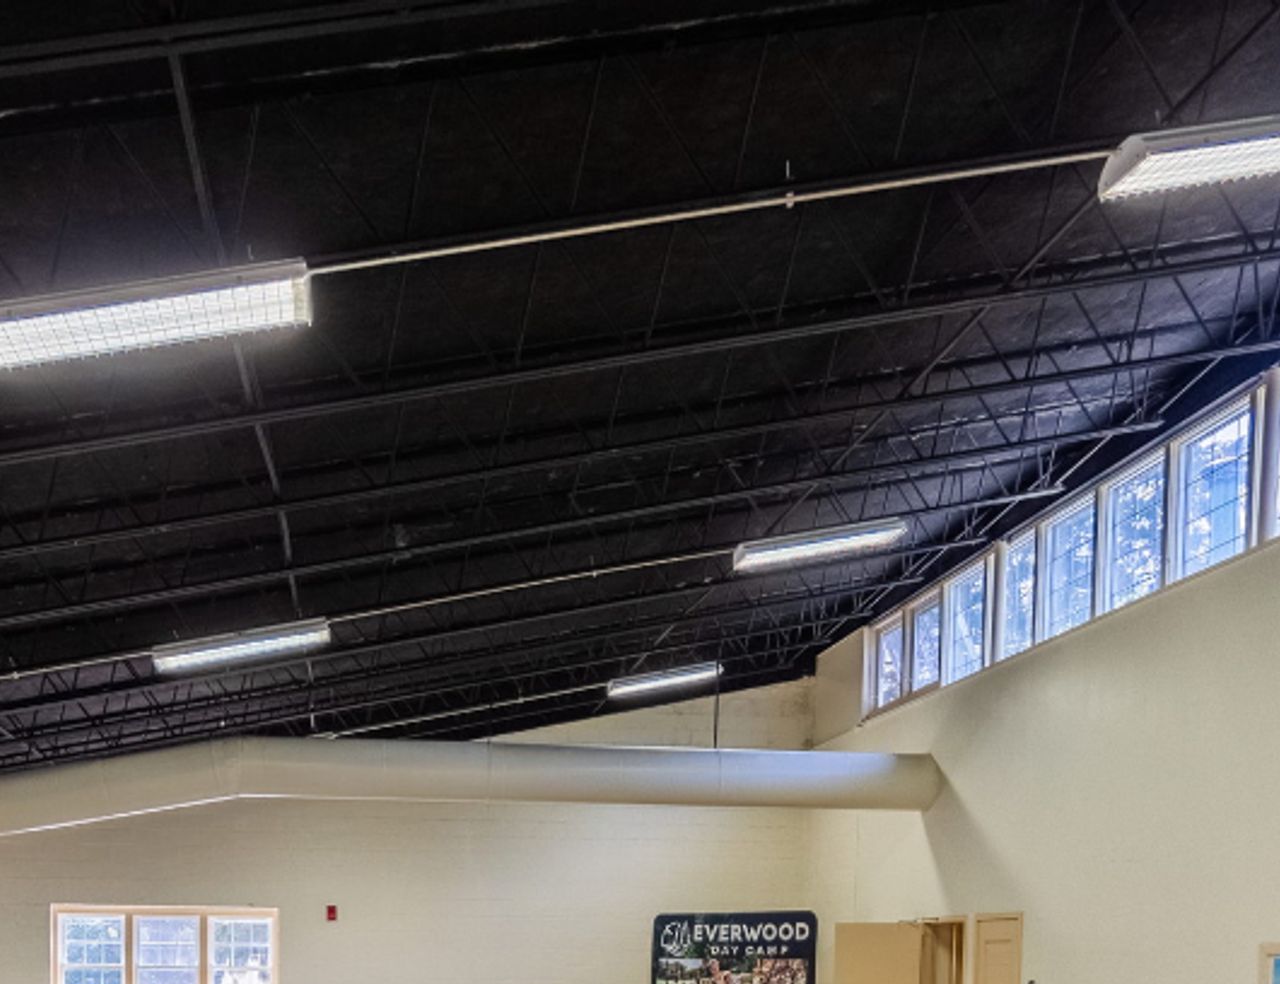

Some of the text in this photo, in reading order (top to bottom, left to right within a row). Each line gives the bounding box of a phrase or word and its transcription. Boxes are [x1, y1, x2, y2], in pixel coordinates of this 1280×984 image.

[693, 922, 810, 943] EVERWOOD
[710, 945, 790, 956] DAY CAMP
